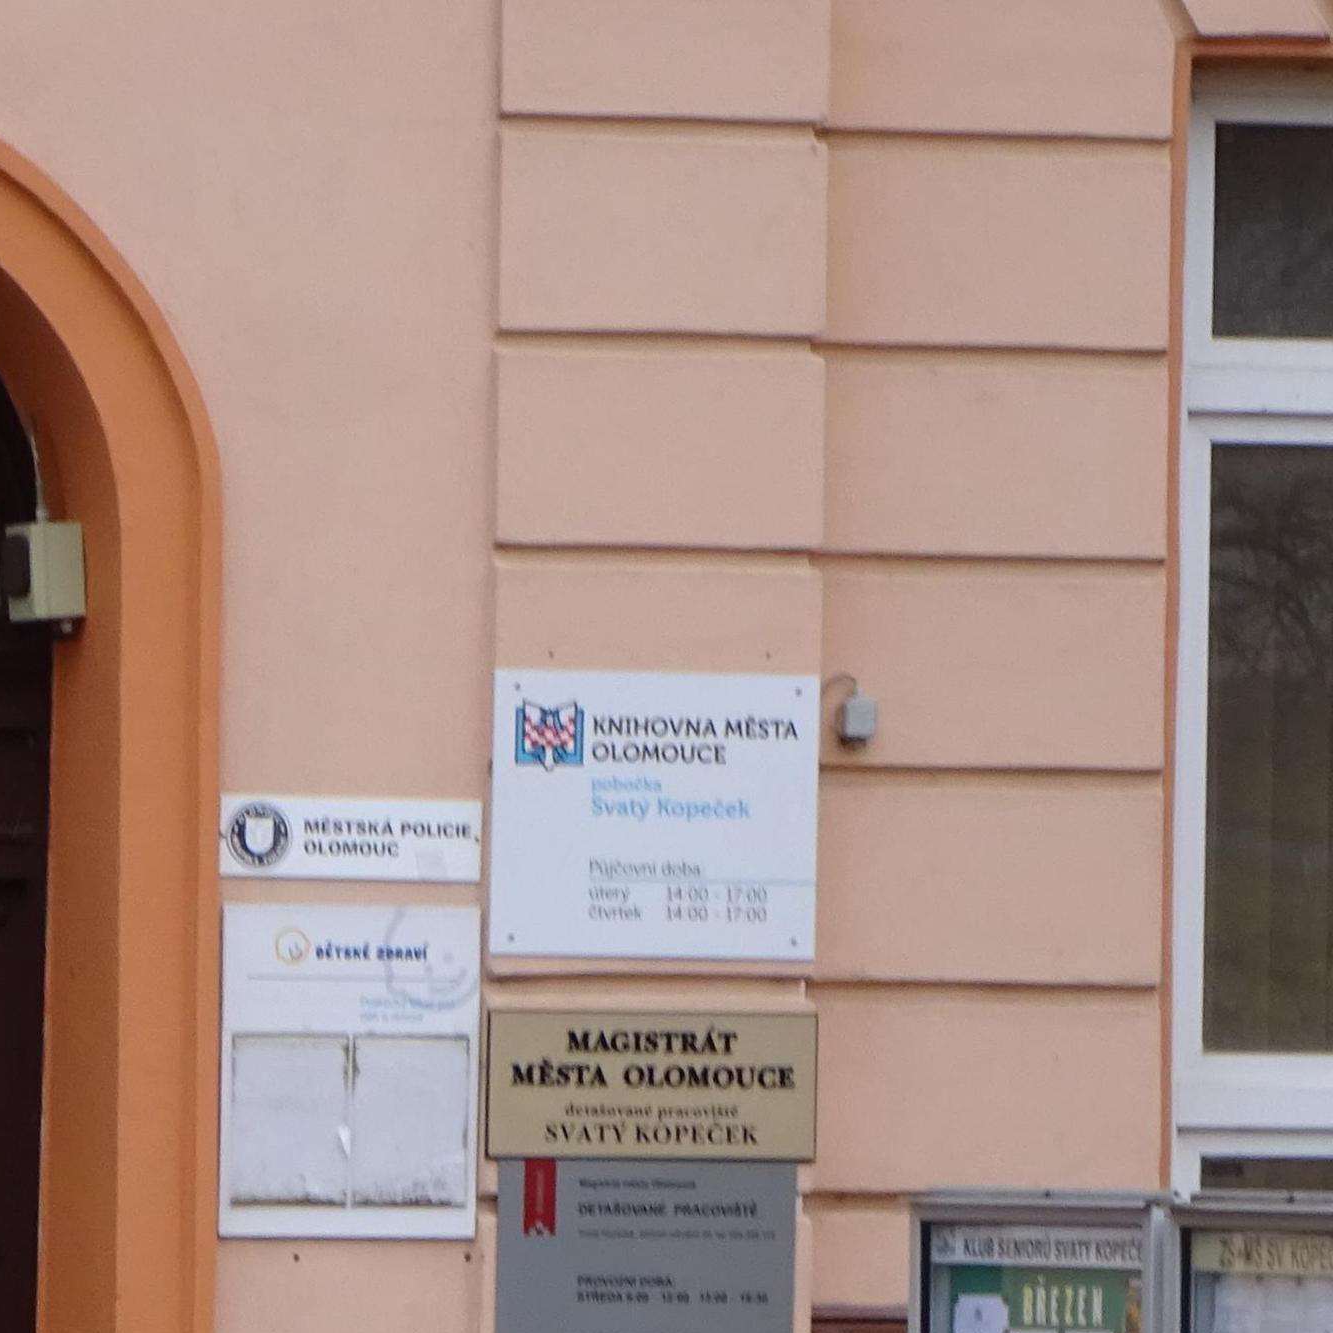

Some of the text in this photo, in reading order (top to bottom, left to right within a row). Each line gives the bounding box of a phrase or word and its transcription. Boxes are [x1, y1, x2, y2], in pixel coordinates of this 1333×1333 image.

[592, 716, 799, 740] KNIHOVNA MĚSTA
[592, 742, 726, 764] OLOMOUCE
[303, 816, 471, 838] MĚSTSKÁ POLICIE
[303, 840, 400, 858] OLOMOUC
[566, 1024, 738, 1053] MAGISTRÁT
[511, 1056, 795, 1090] MĚSTA OLOMOUCE
[544, 1121, 759, 1146] SVATÝ KOPEČEK
